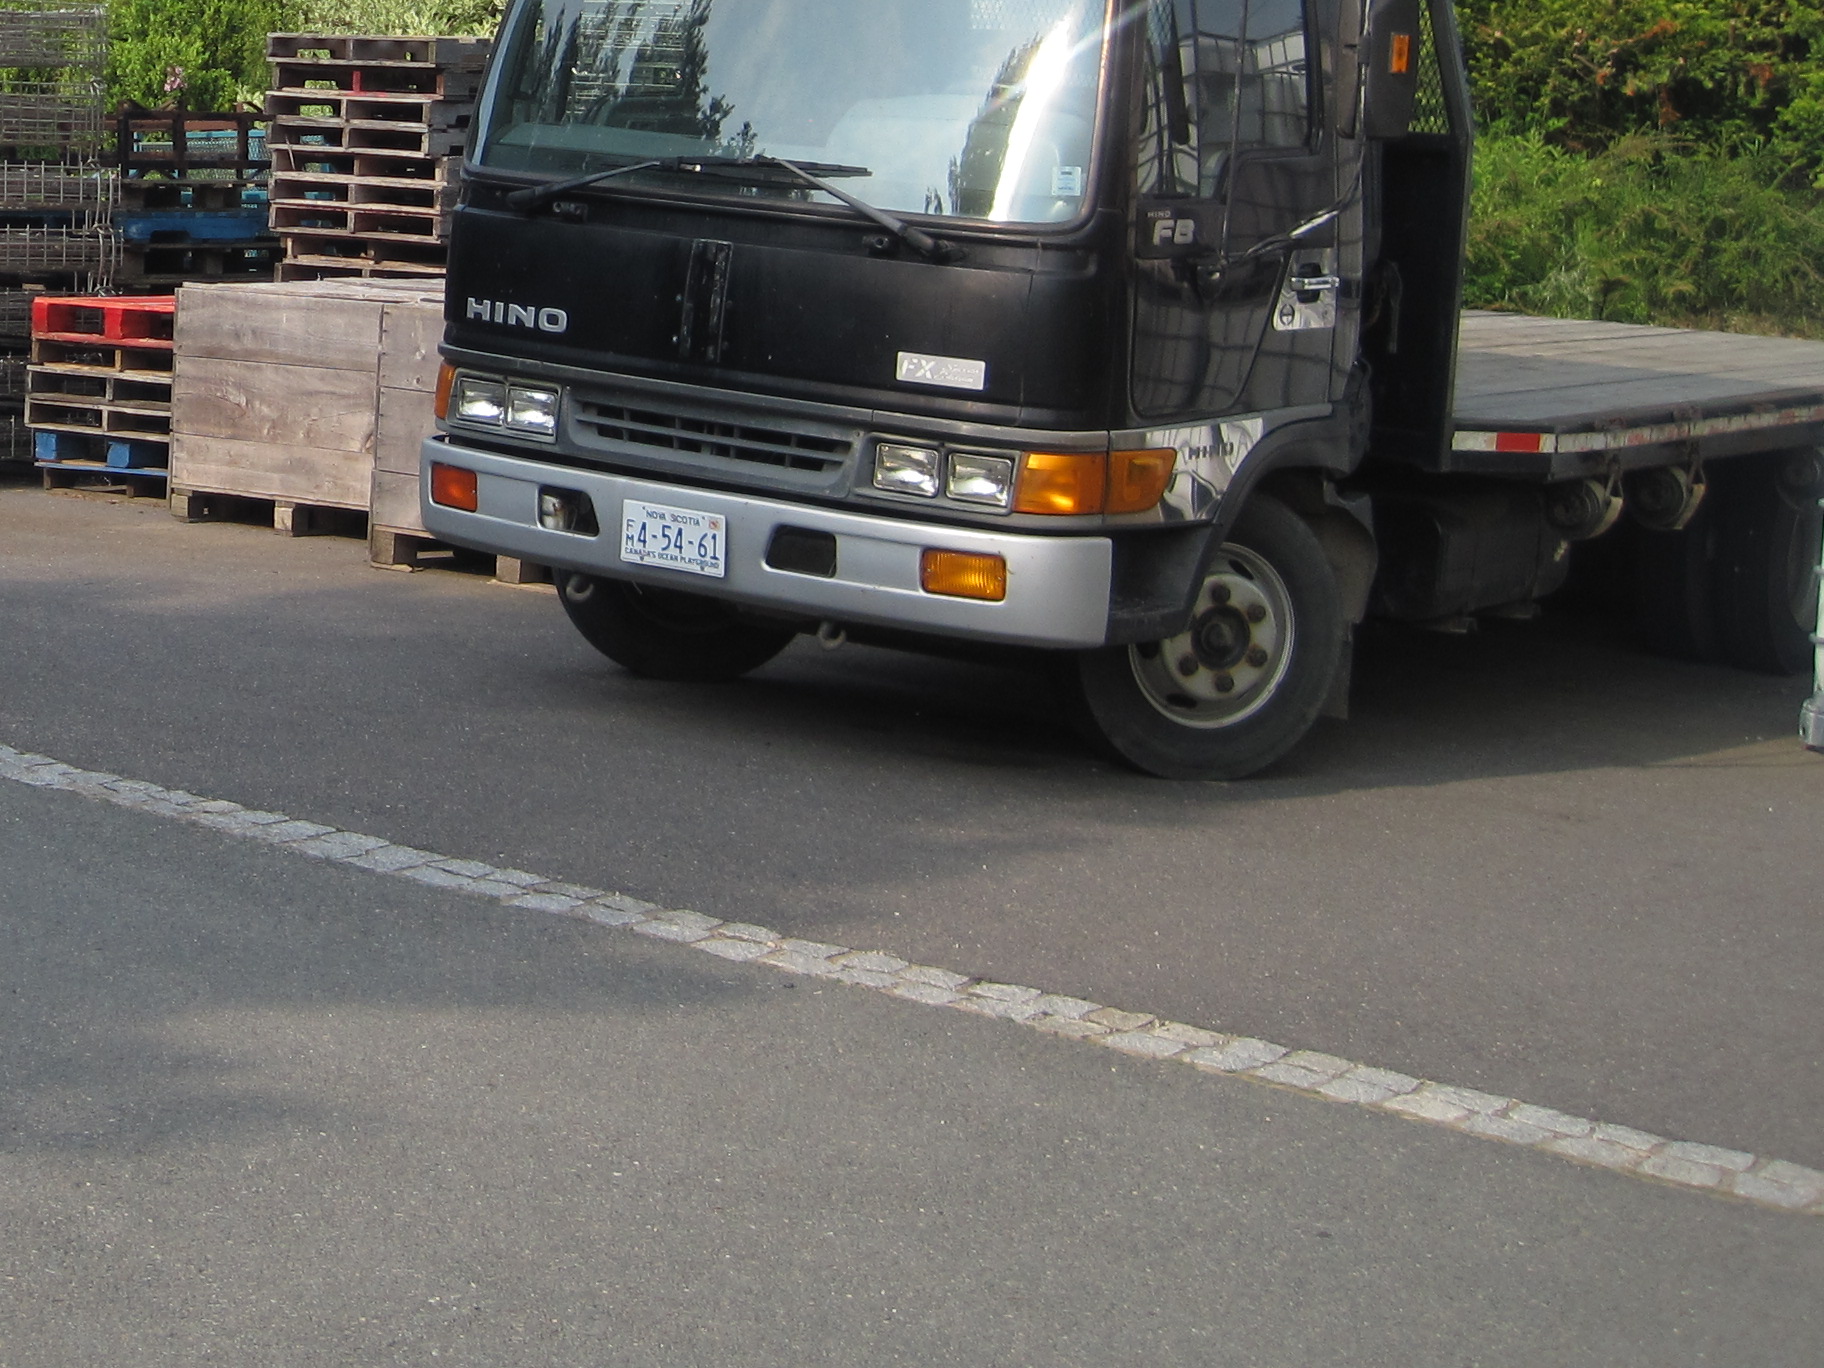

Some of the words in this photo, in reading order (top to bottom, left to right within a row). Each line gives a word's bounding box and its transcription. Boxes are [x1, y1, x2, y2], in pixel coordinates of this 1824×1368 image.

[1147, 210, 1171, 218] HINO
[466, 296, 568, 333] HINO
[901, 358, 936, 380] FX
[646, 509, 667, 521] NOVA
[670, 513, 701, 527] SCOTIA
[637, 521, 720, 561] 4-54-61
[657, 552, 679, 563] OCEAN
